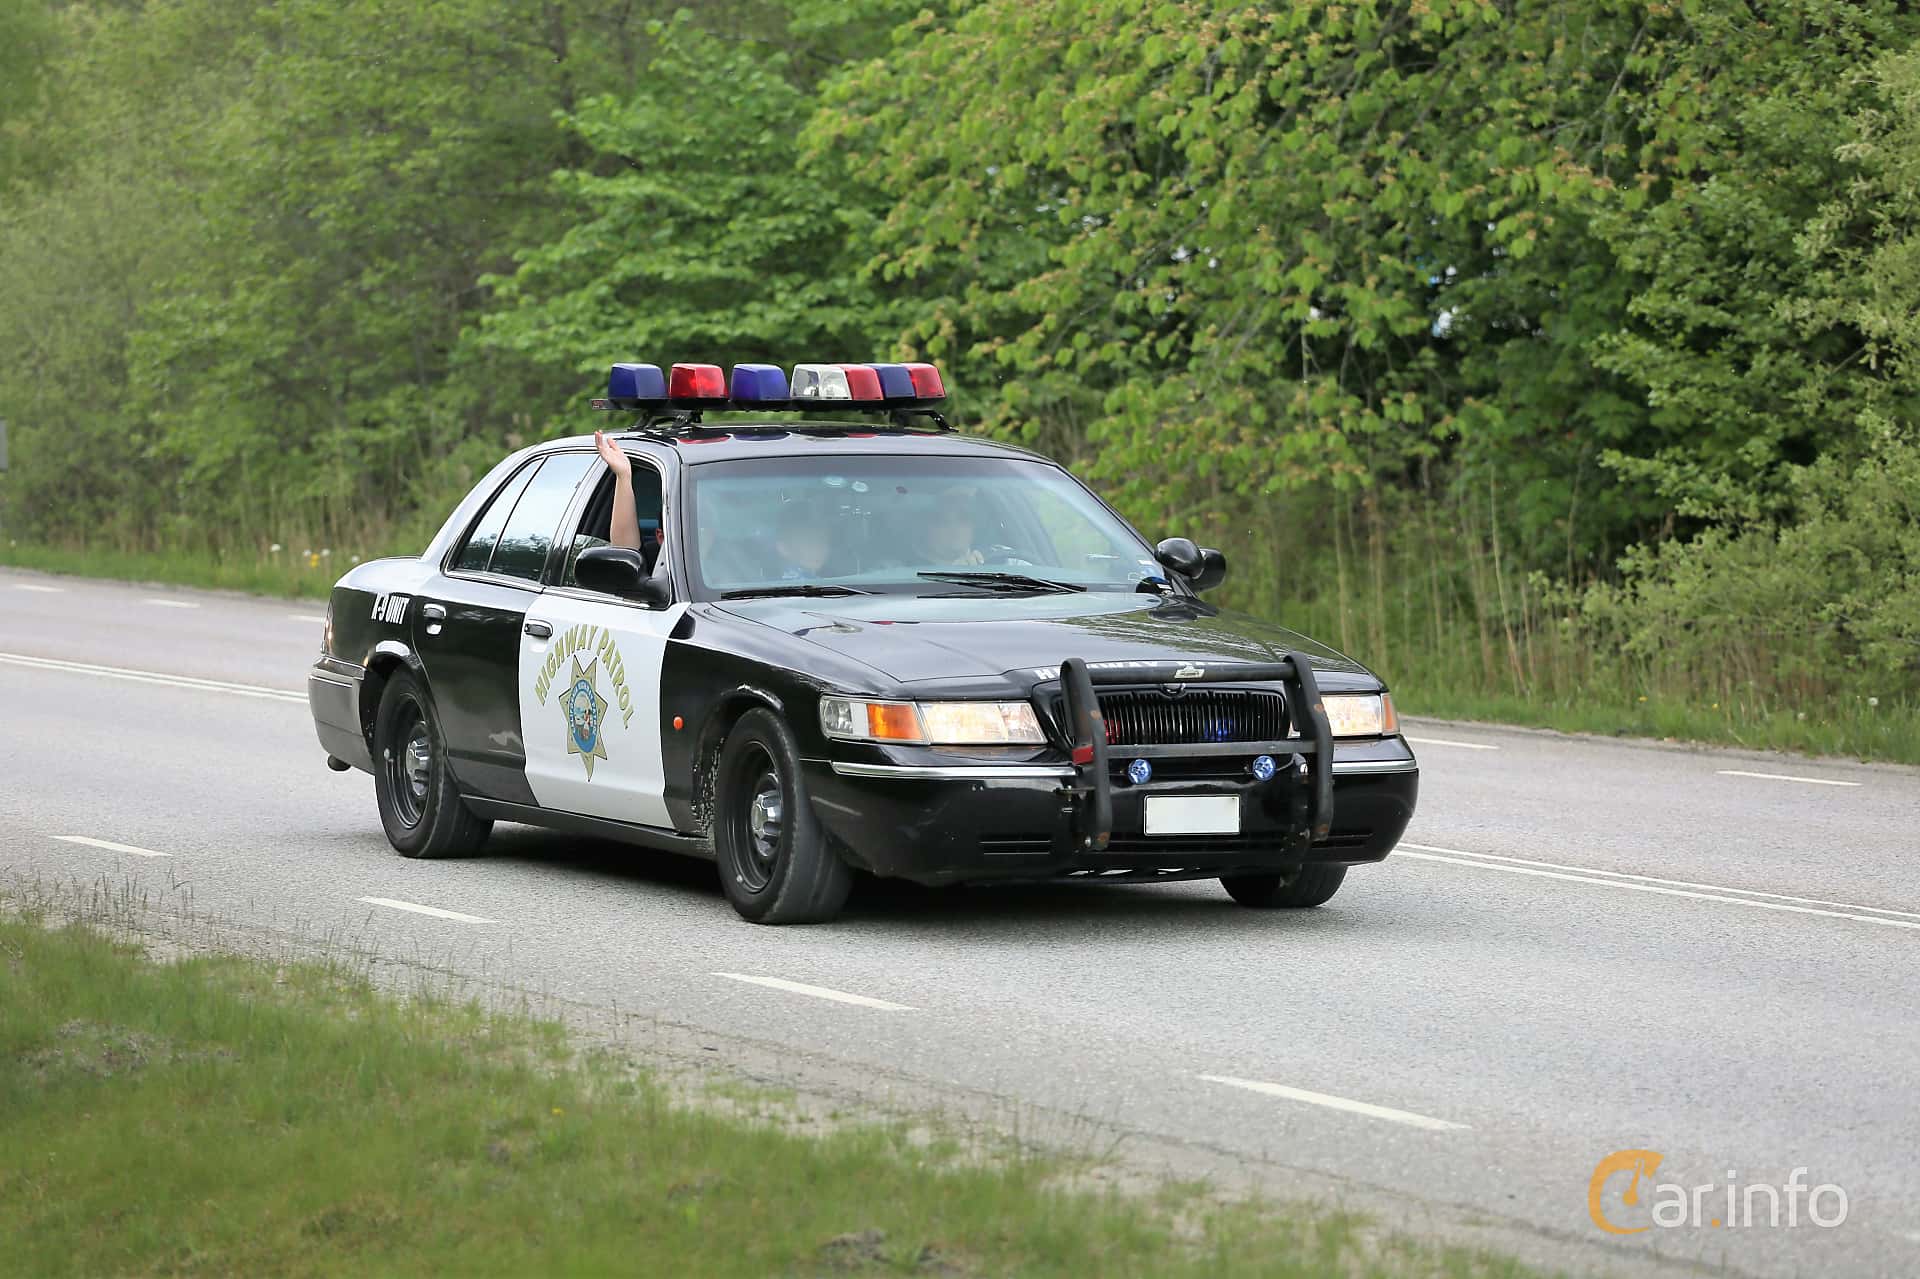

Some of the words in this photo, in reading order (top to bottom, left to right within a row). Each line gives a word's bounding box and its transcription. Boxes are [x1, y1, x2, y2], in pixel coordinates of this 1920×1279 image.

[385, 595, 410, 625] UNIT
[534, 624, 598, 706] HIGHWAY
[596, 629, 633, 729] PATROL
